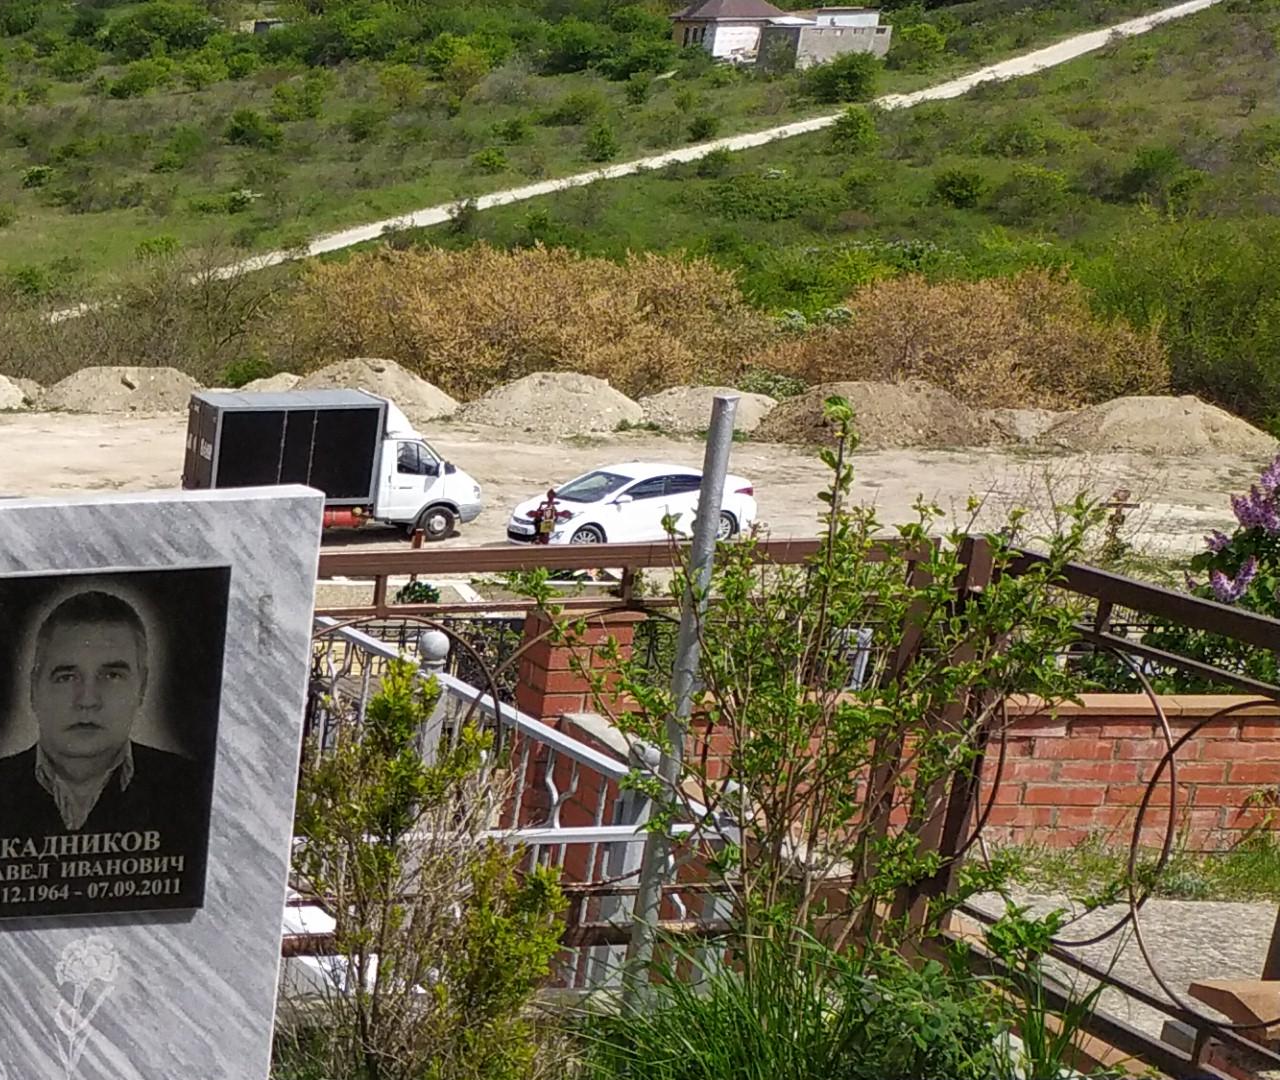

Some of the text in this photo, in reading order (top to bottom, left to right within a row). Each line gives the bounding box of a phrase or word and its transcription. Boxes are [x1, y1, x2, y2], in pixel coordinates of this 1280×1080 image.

[0, 831, 161, 859] КАДНИКОВ
[60, 855, 184, 878] ИВАНОВИЧ
[88, 878, 181, 899] 07.09.2011
